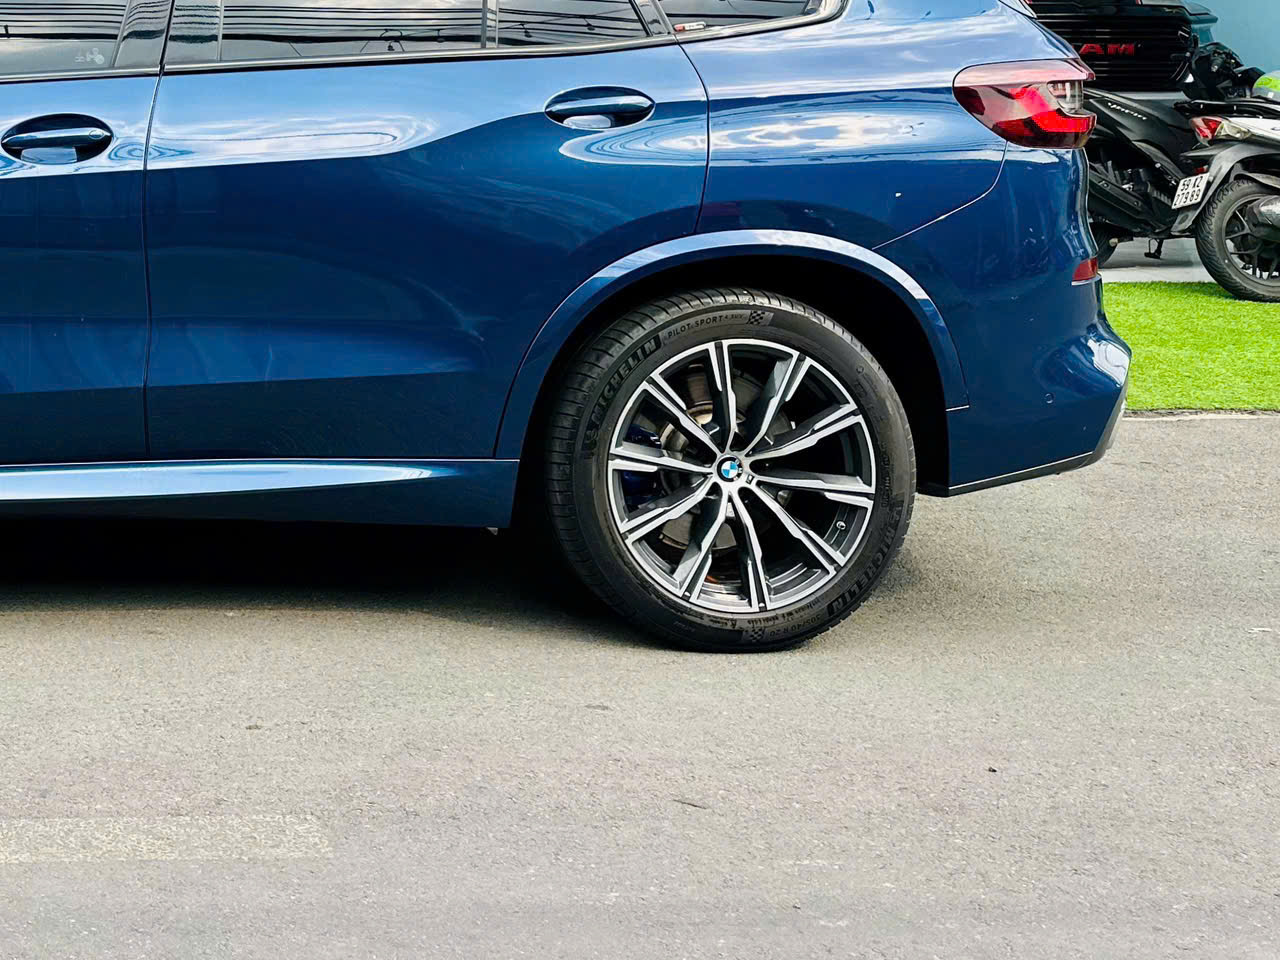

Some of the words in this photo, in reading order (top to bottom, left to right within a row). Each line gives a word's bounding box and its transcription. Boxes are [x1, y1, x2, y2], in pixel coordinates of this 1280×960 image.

[1072, 43, 1135, 56] AM
[1180, 178, 1192, 192] 59
[668, 324, 691, 339] PILOT
[694, 315, 723, 328] SPORT
[592, 339, 657, 422] MICHELIN
[832, 527, 896, 613] MICHELIN
